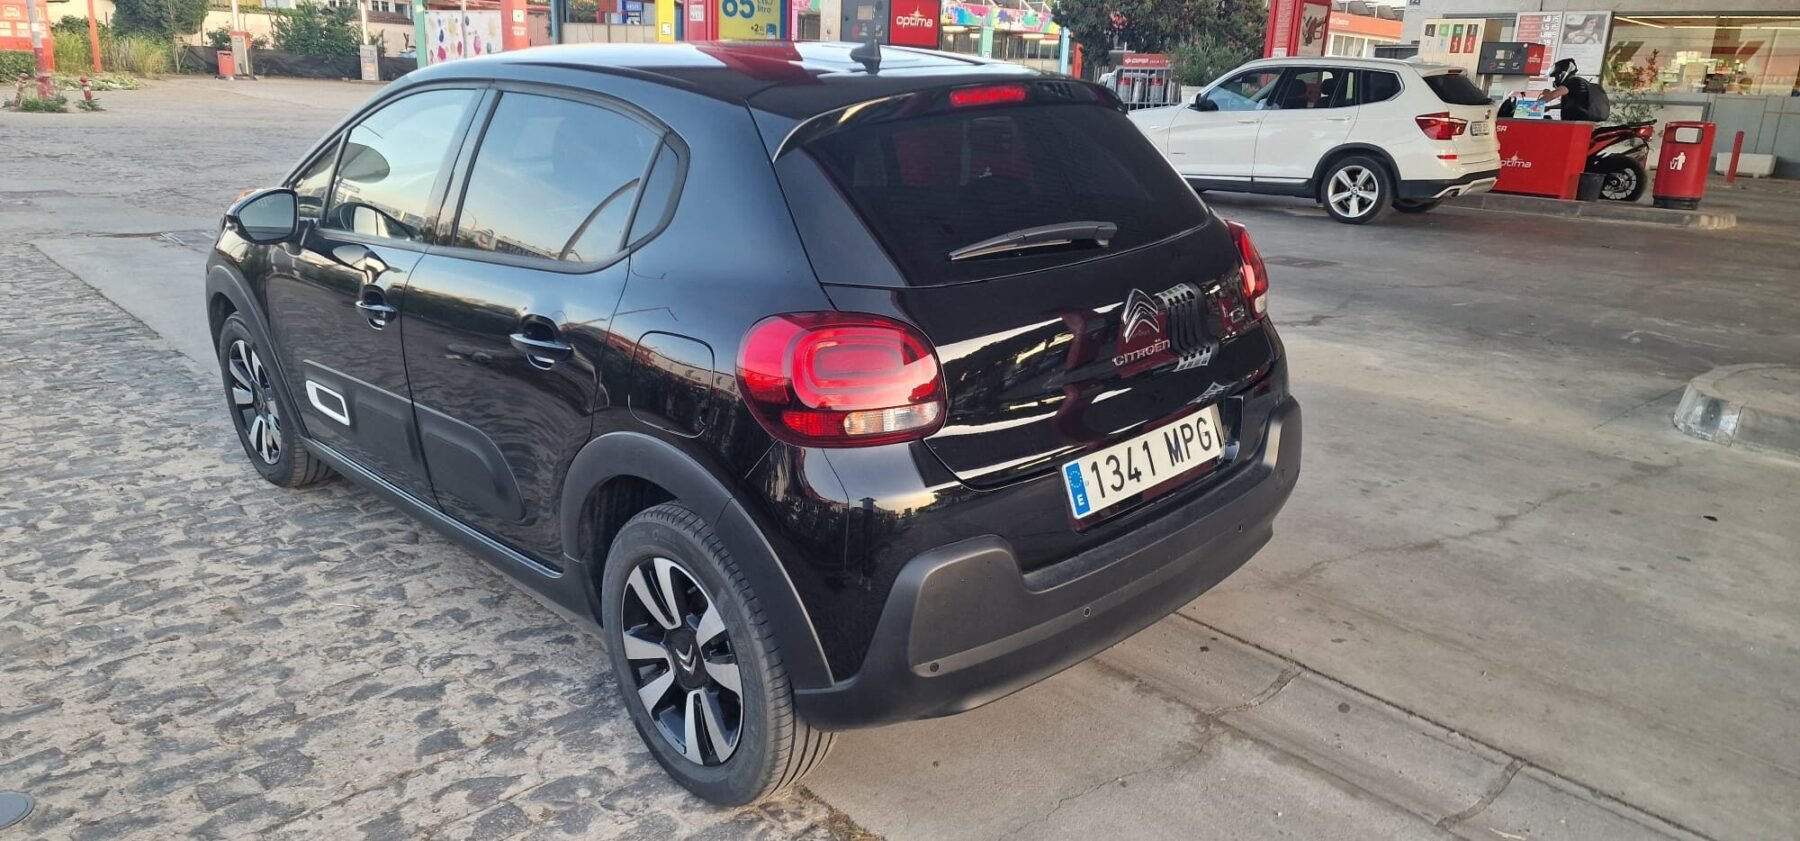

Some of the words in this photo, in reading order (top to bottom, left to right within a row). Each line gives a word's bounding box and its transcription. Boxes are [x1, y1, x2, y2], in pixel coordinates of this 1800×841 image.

[896, 16, 933, 29] optima
[1500, 160, 1532, 169] ptima
[1112, 339, 1170, 366] CITROËN
[1090, 440, 1156, 498] 1341
[1163, 417, 1212, 467] MPG
[1077, 494, 1085, 506] E
